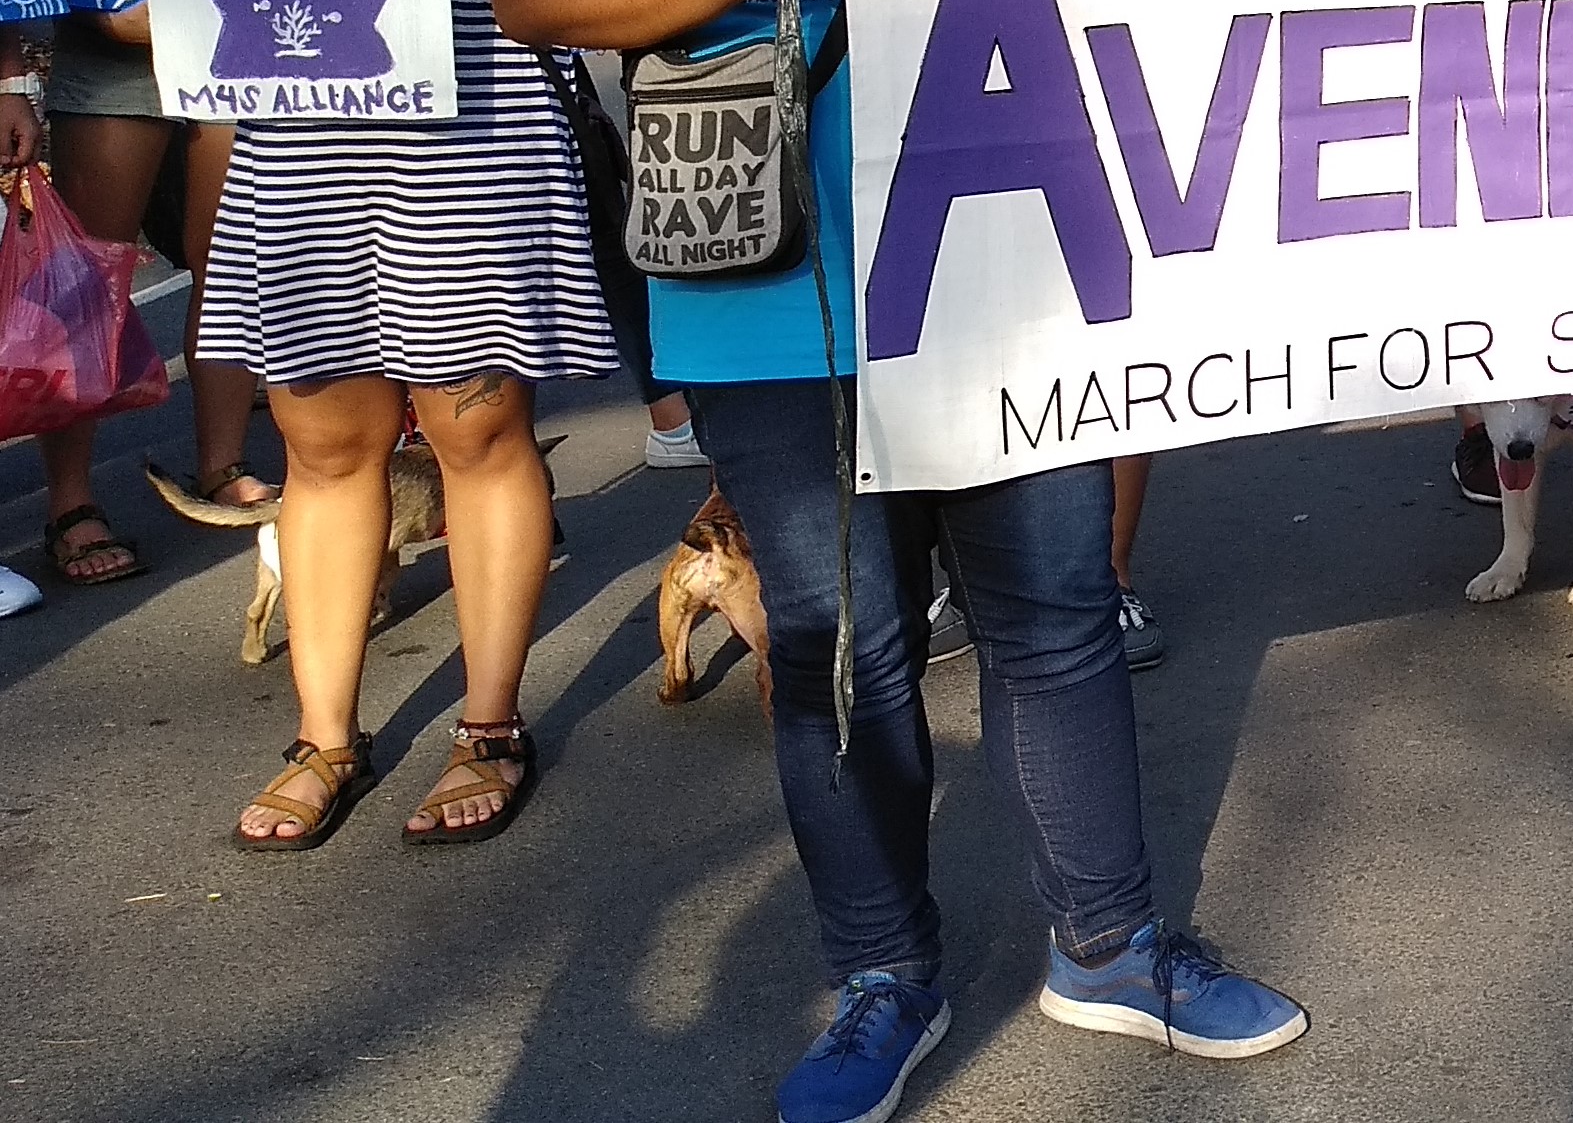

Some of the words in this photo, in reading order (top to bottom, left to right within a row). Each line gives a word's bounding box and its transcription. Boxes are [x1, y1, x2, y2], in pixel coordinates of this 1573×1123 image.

[178, 83, 262, 115] M4S
[272, 79, 435, 117] ALLIANCE
[637, 104, 772, 165] RUN
[637, 167, 686, 194] ALL
[693, 161, 766, 194] DAY
[640, 189, 765, 240] RAVE
[635, 240, 675, 267] ALL
[680, 233, 767, 266] NIGHT
[1000, 343, 1293, 456] MARCH
[1328, 321, 1496, 402] FOR
